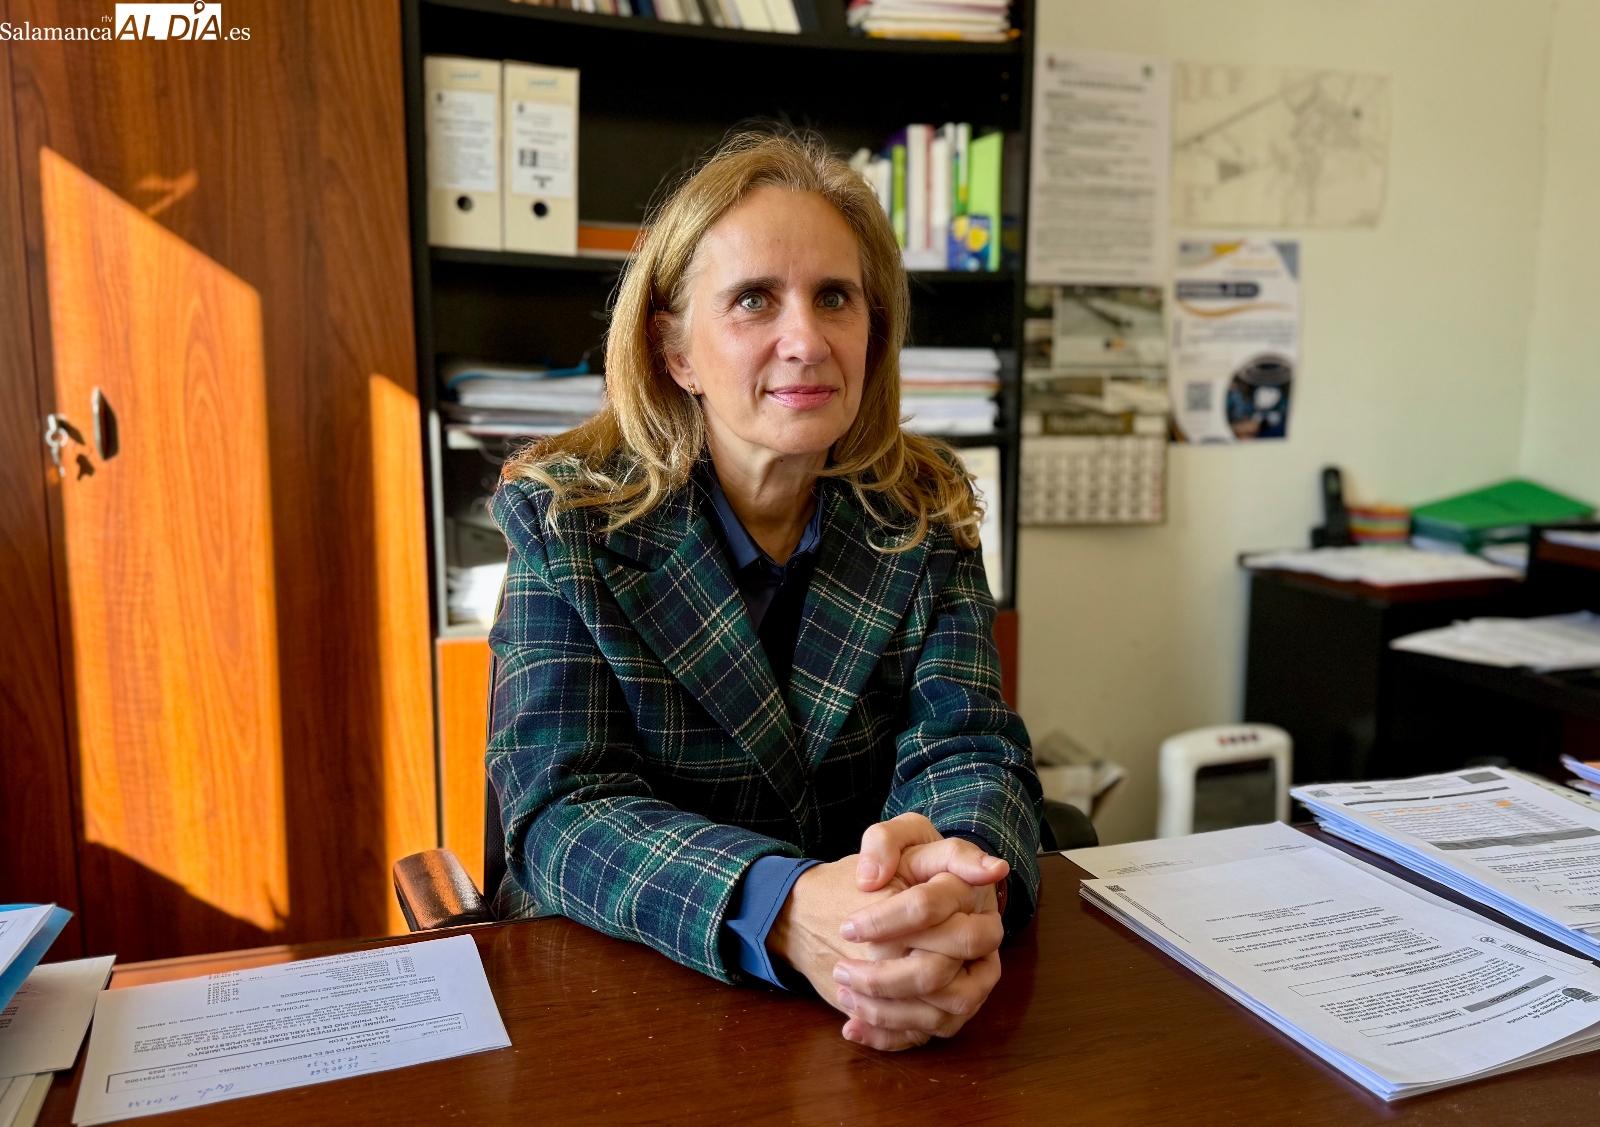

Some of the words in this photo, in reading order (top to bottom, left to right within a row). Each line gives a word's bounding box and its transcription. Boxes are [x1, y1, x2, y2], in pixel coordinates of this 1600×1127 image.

[275, 1003, 309, 1013] INFORME
[333, 1017, 372, 1027] PRINCIPIO
[362, 1016, 396, 1026] INFORME
[268, 1026, 320, 1039] ESTABILIDAD
[355, 1029, 389, 1039] CASTILLA
[193, 1035, 268, 1052] PRESUPUESTARIA
[261, 1035, 290, 1044] SOBRE
[345, 1034, 390, 1046] SALAMANCA
[186, 1042, 248, 1058] CUMPLIMIENTO
[334, 1038, 391, 1052] AYUNTAMIENTO
[275, 1053, 312, 1063] PEDROSO
